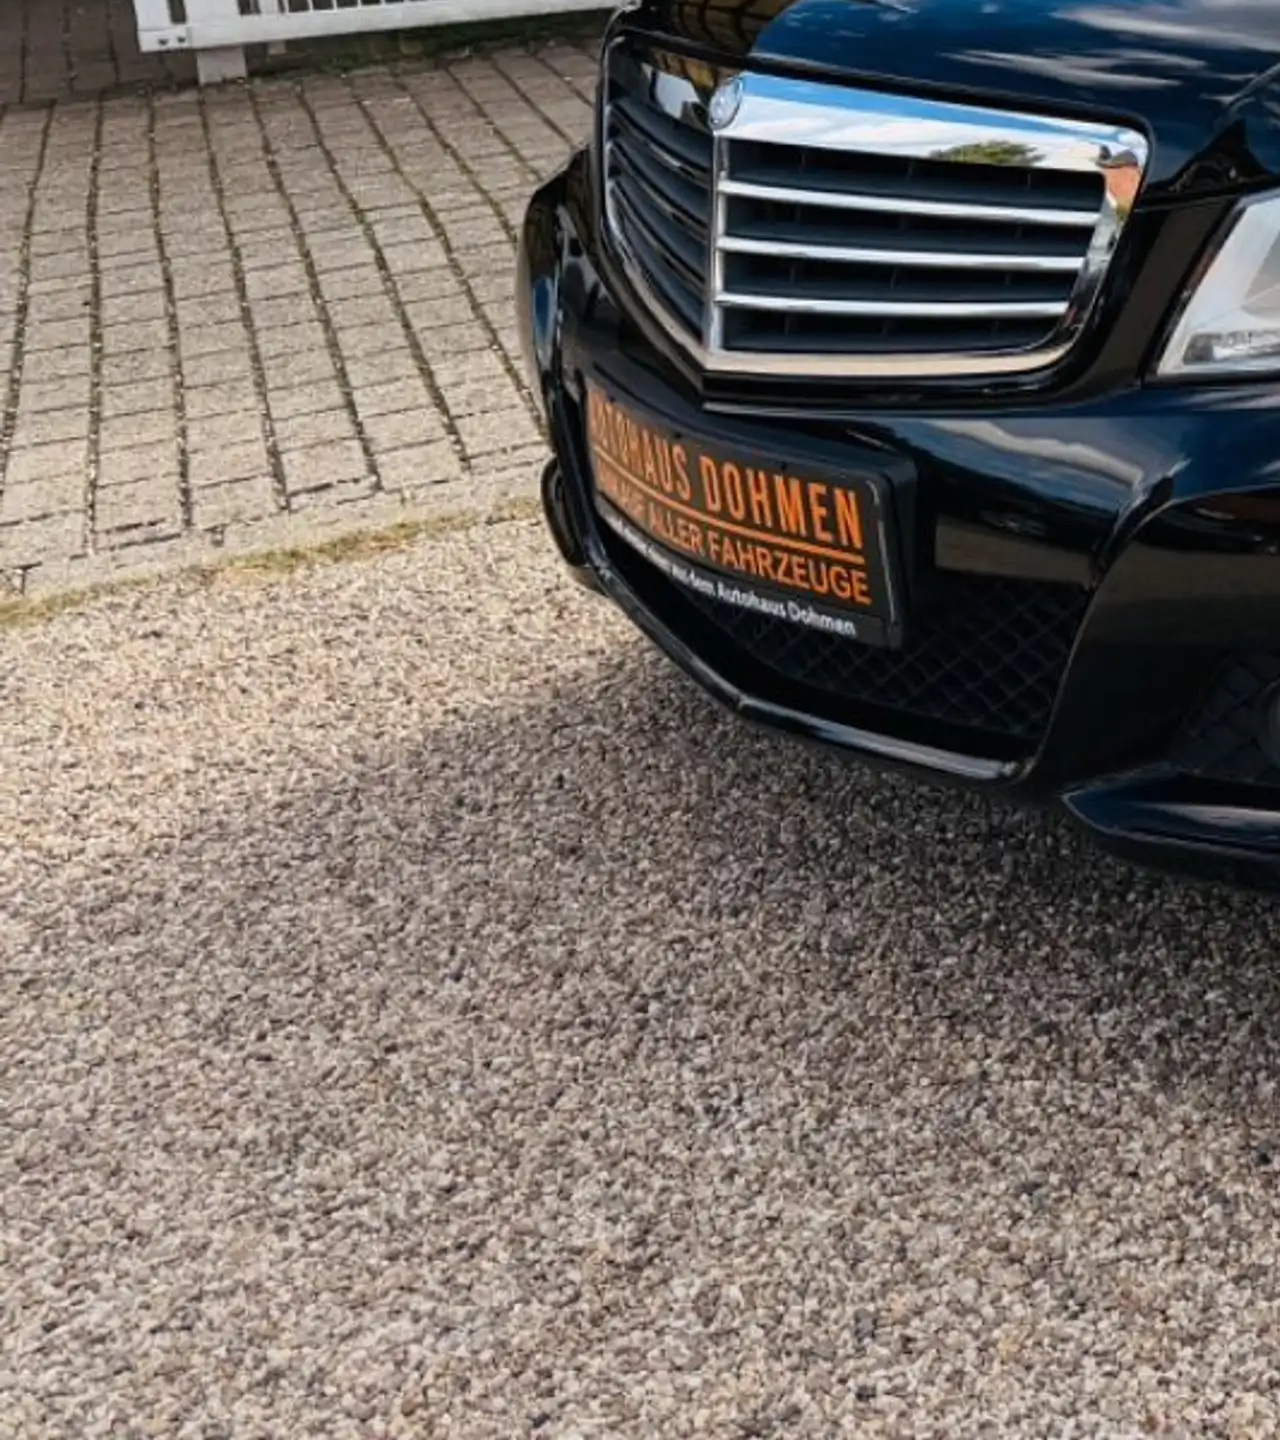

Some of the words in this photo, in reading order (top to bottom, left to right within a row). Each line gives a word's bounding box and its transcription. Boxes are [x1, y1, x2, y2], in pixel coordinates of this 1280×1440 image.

[699, 454, 864, 551] DOHMEN
[707, 529, 872, 606] FAHRZEUGE
[787, 599, 858, 638] Dohmen
